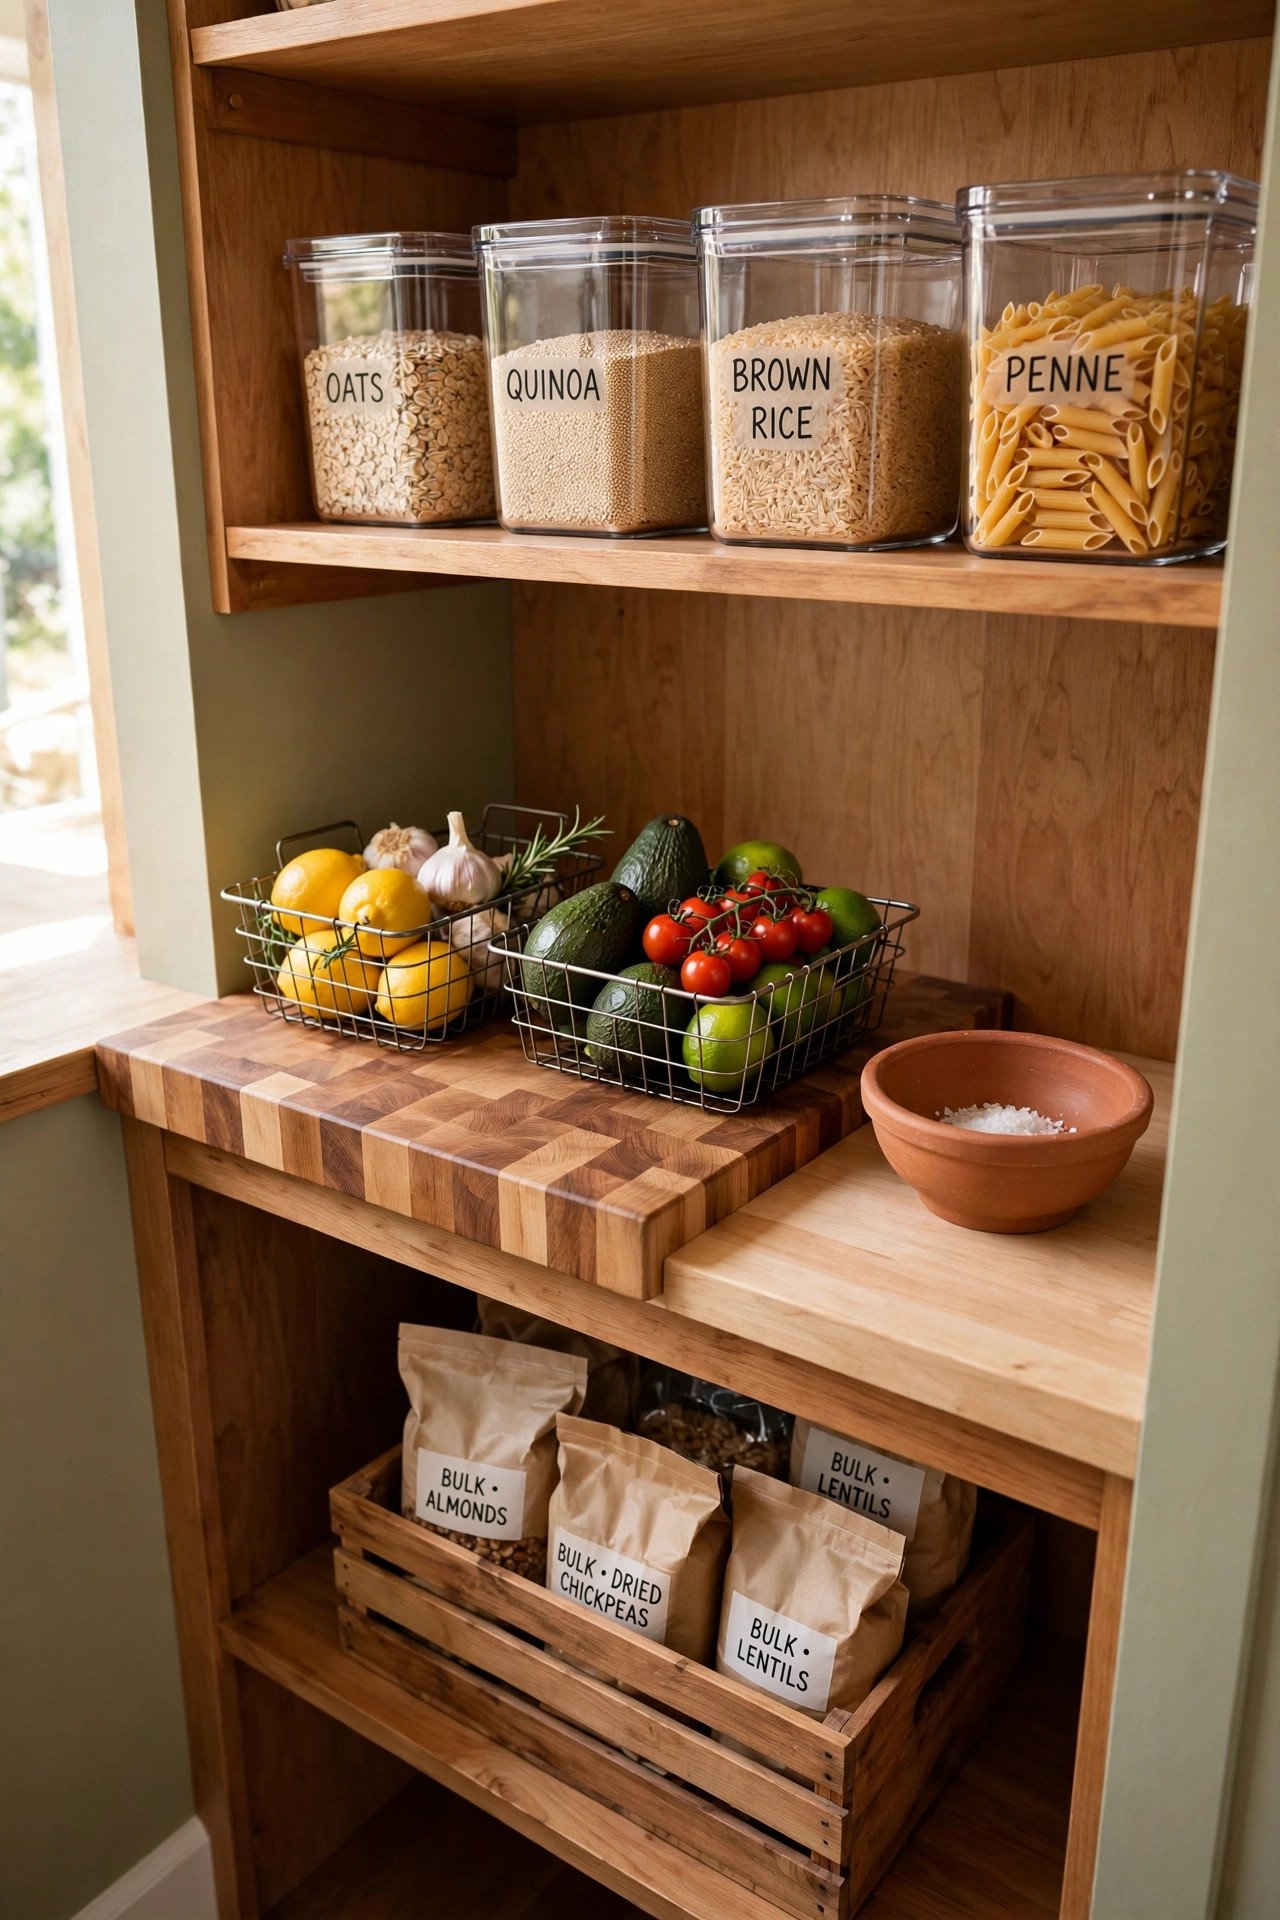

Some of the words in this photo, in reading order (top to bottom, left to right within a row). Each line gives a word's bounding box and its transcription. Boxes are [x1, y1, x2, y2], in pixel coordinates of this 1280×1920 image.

[326, 372, 384, 404] OATS
[506, 368, 601, 402] QUINOA
[732, 357, 831, 393] BROWN
[1006, 354, 1125, 393] PENNE
[751, 405, 813, 440] RICE
[441, 1467, 486, 1496] BULK
[831, 1451, 878, 1486] BULK
[426, 1490, 508, 1526] ALMONDS
[817, 1473, 892, 1520] LENTILS
[557, 1542, 597, 1578] BULK
[610, 1568, 662, 1606] DRIED
[560, 1571, 649, 1628] CHICKPEAS
[750, 1617, 798, 1658] BULK
[737, 1638, 810, 1692] LENTILS
